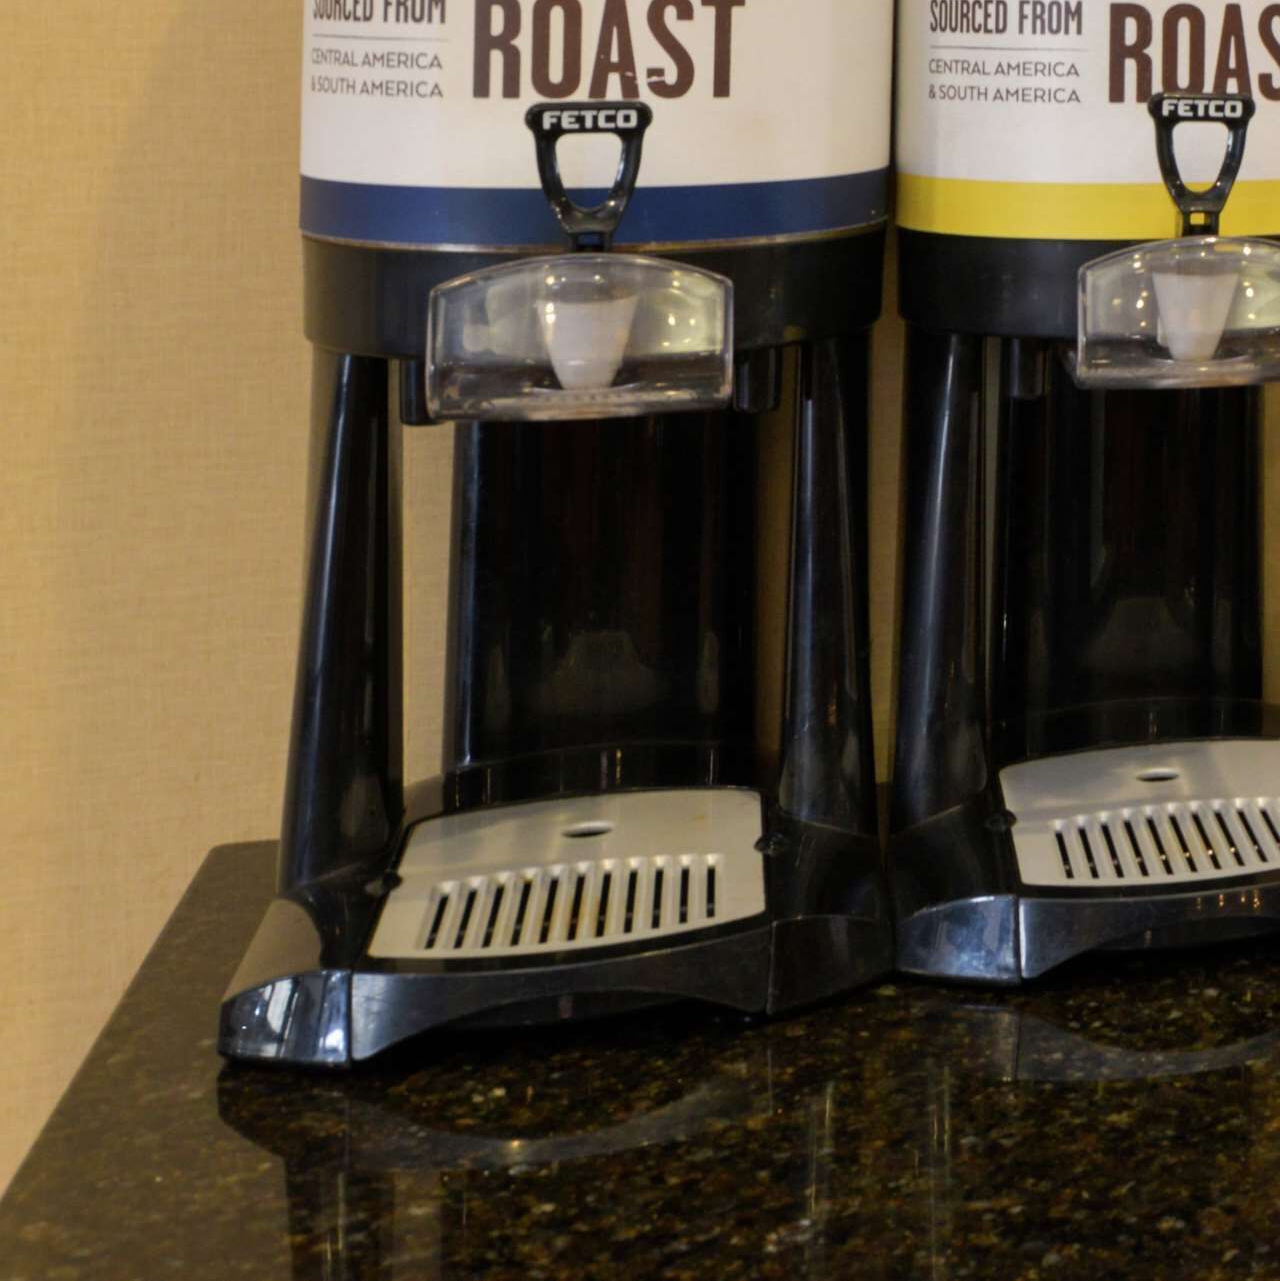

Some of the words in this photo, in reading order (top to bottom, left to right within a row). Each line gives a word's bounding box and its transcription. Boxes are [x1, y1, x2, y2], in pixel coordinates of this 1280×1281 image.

[1018, 0, 1083, 36] FROM
[311, 47, 359, 67] CENTRAL
[361, 50, 443, 70] AMERICA
[928, 58, 991, 76] CENTRAL
[994, 61, 1081, 78] AMERICA
[318, 75, 357, 95] SOUTH
[359, 79, 444, 99] AMERICA
[928, 83, 936, 101] &
[938, 84, 988, 102] SOUTH
[992, 86, 1081, 104] AMERICA
[1161, 98, 1243, 119] FETCO
[542, 109, 638, 131] FETCO
